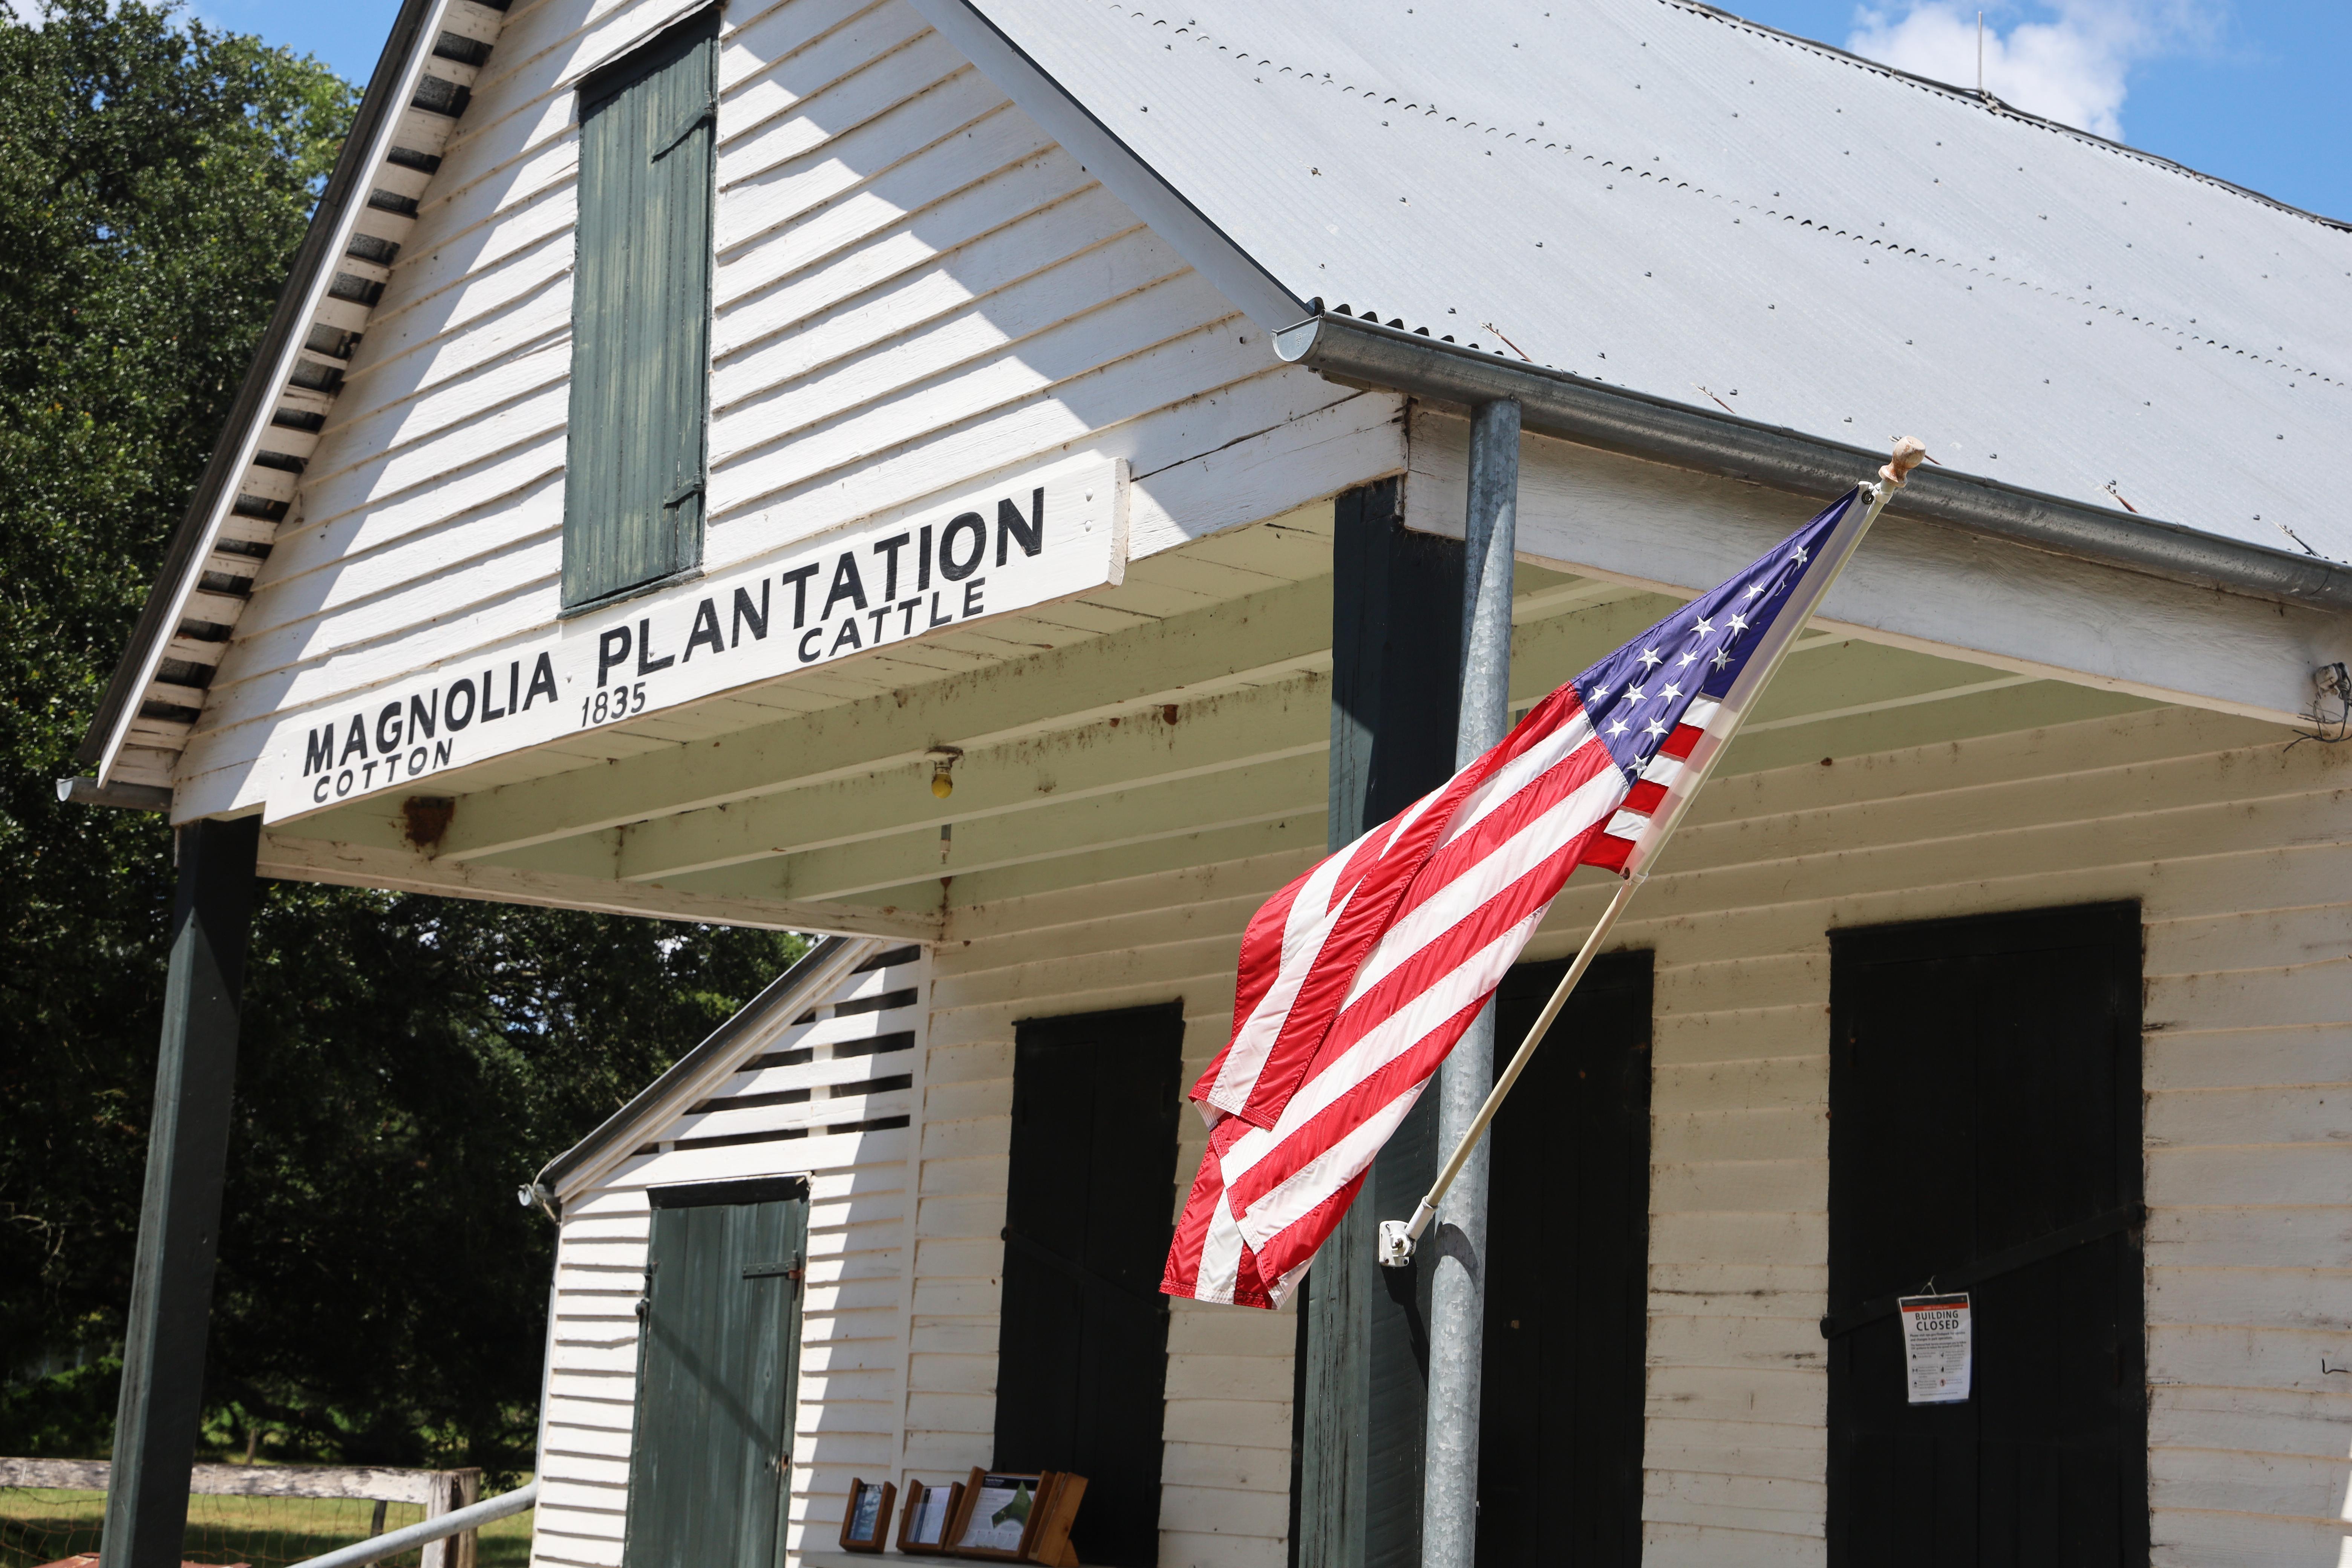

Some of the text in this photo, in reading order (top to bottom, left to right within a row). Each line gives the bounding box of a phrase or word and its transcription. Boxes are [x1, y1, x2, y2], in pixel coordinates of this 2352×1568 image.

[303, 486, 1044, 777] MAGNOLIA PLANTATION
[314, 577, 985, 803] COTTON 1835 CATTLE
[1915, 1310, 1958, 1320] BUILDING
[1916, 1319, 1959, 1331] CLOSED
